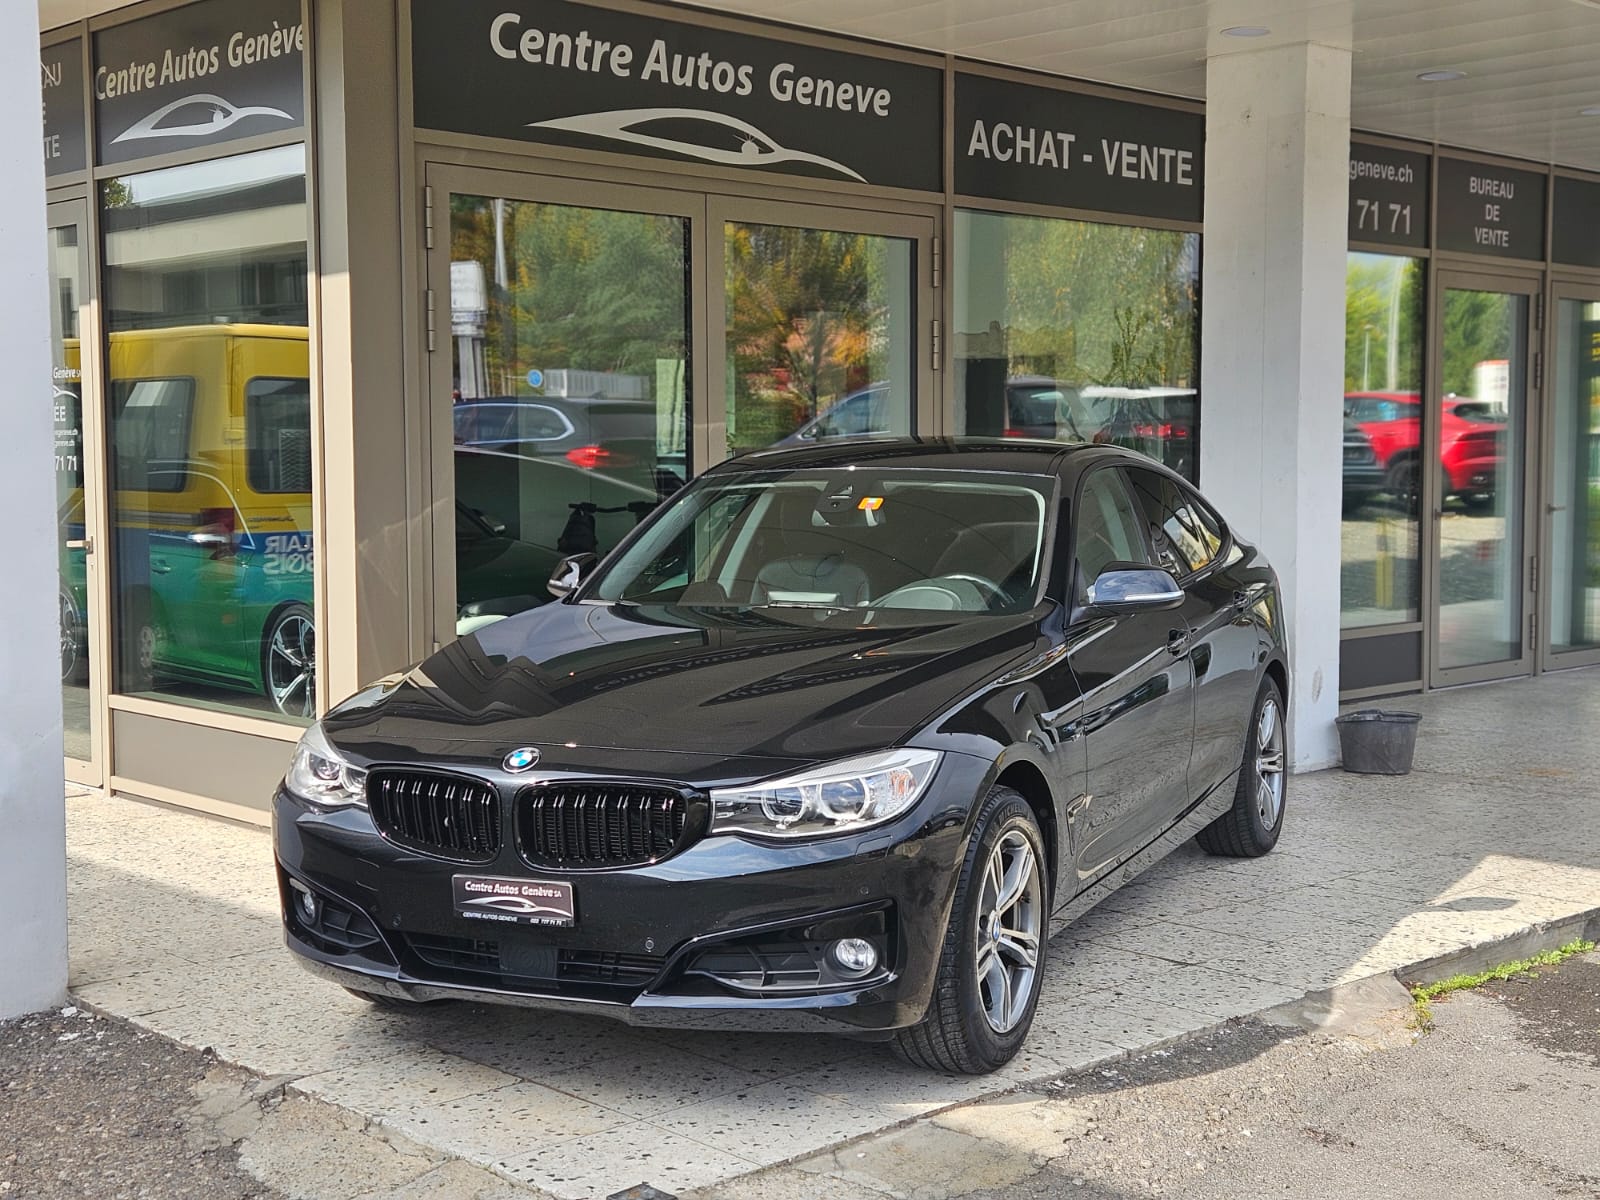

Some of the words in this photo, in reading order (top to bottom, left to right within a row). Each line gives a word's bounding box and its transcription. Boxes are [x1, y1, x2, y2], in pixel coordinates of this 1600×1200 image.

[95, 65, 156, 100] Centre
[159, 46, 219, 86] Autos
[489, 12, 633, 77] Centre
[641, 39, 754, 96] Autos
[769, 63, 892, 117] Geneve
[967, 119, 1076, 170] ACHAT
[1101, 138, 1193, 186] VENTE
[1470, 177, 1515, 199] BUREAU
[1356, 199, 1379, 231] 71
[1389, 203, 1411, 235] 71
[1485, 204, 1500, 221] DE
[1475, 227, 1510, 247] VENTE
[67, 455, 77, 471] 71
[465, 881, 493, 893] Centre
[494, 883, 519, 895] Autos
